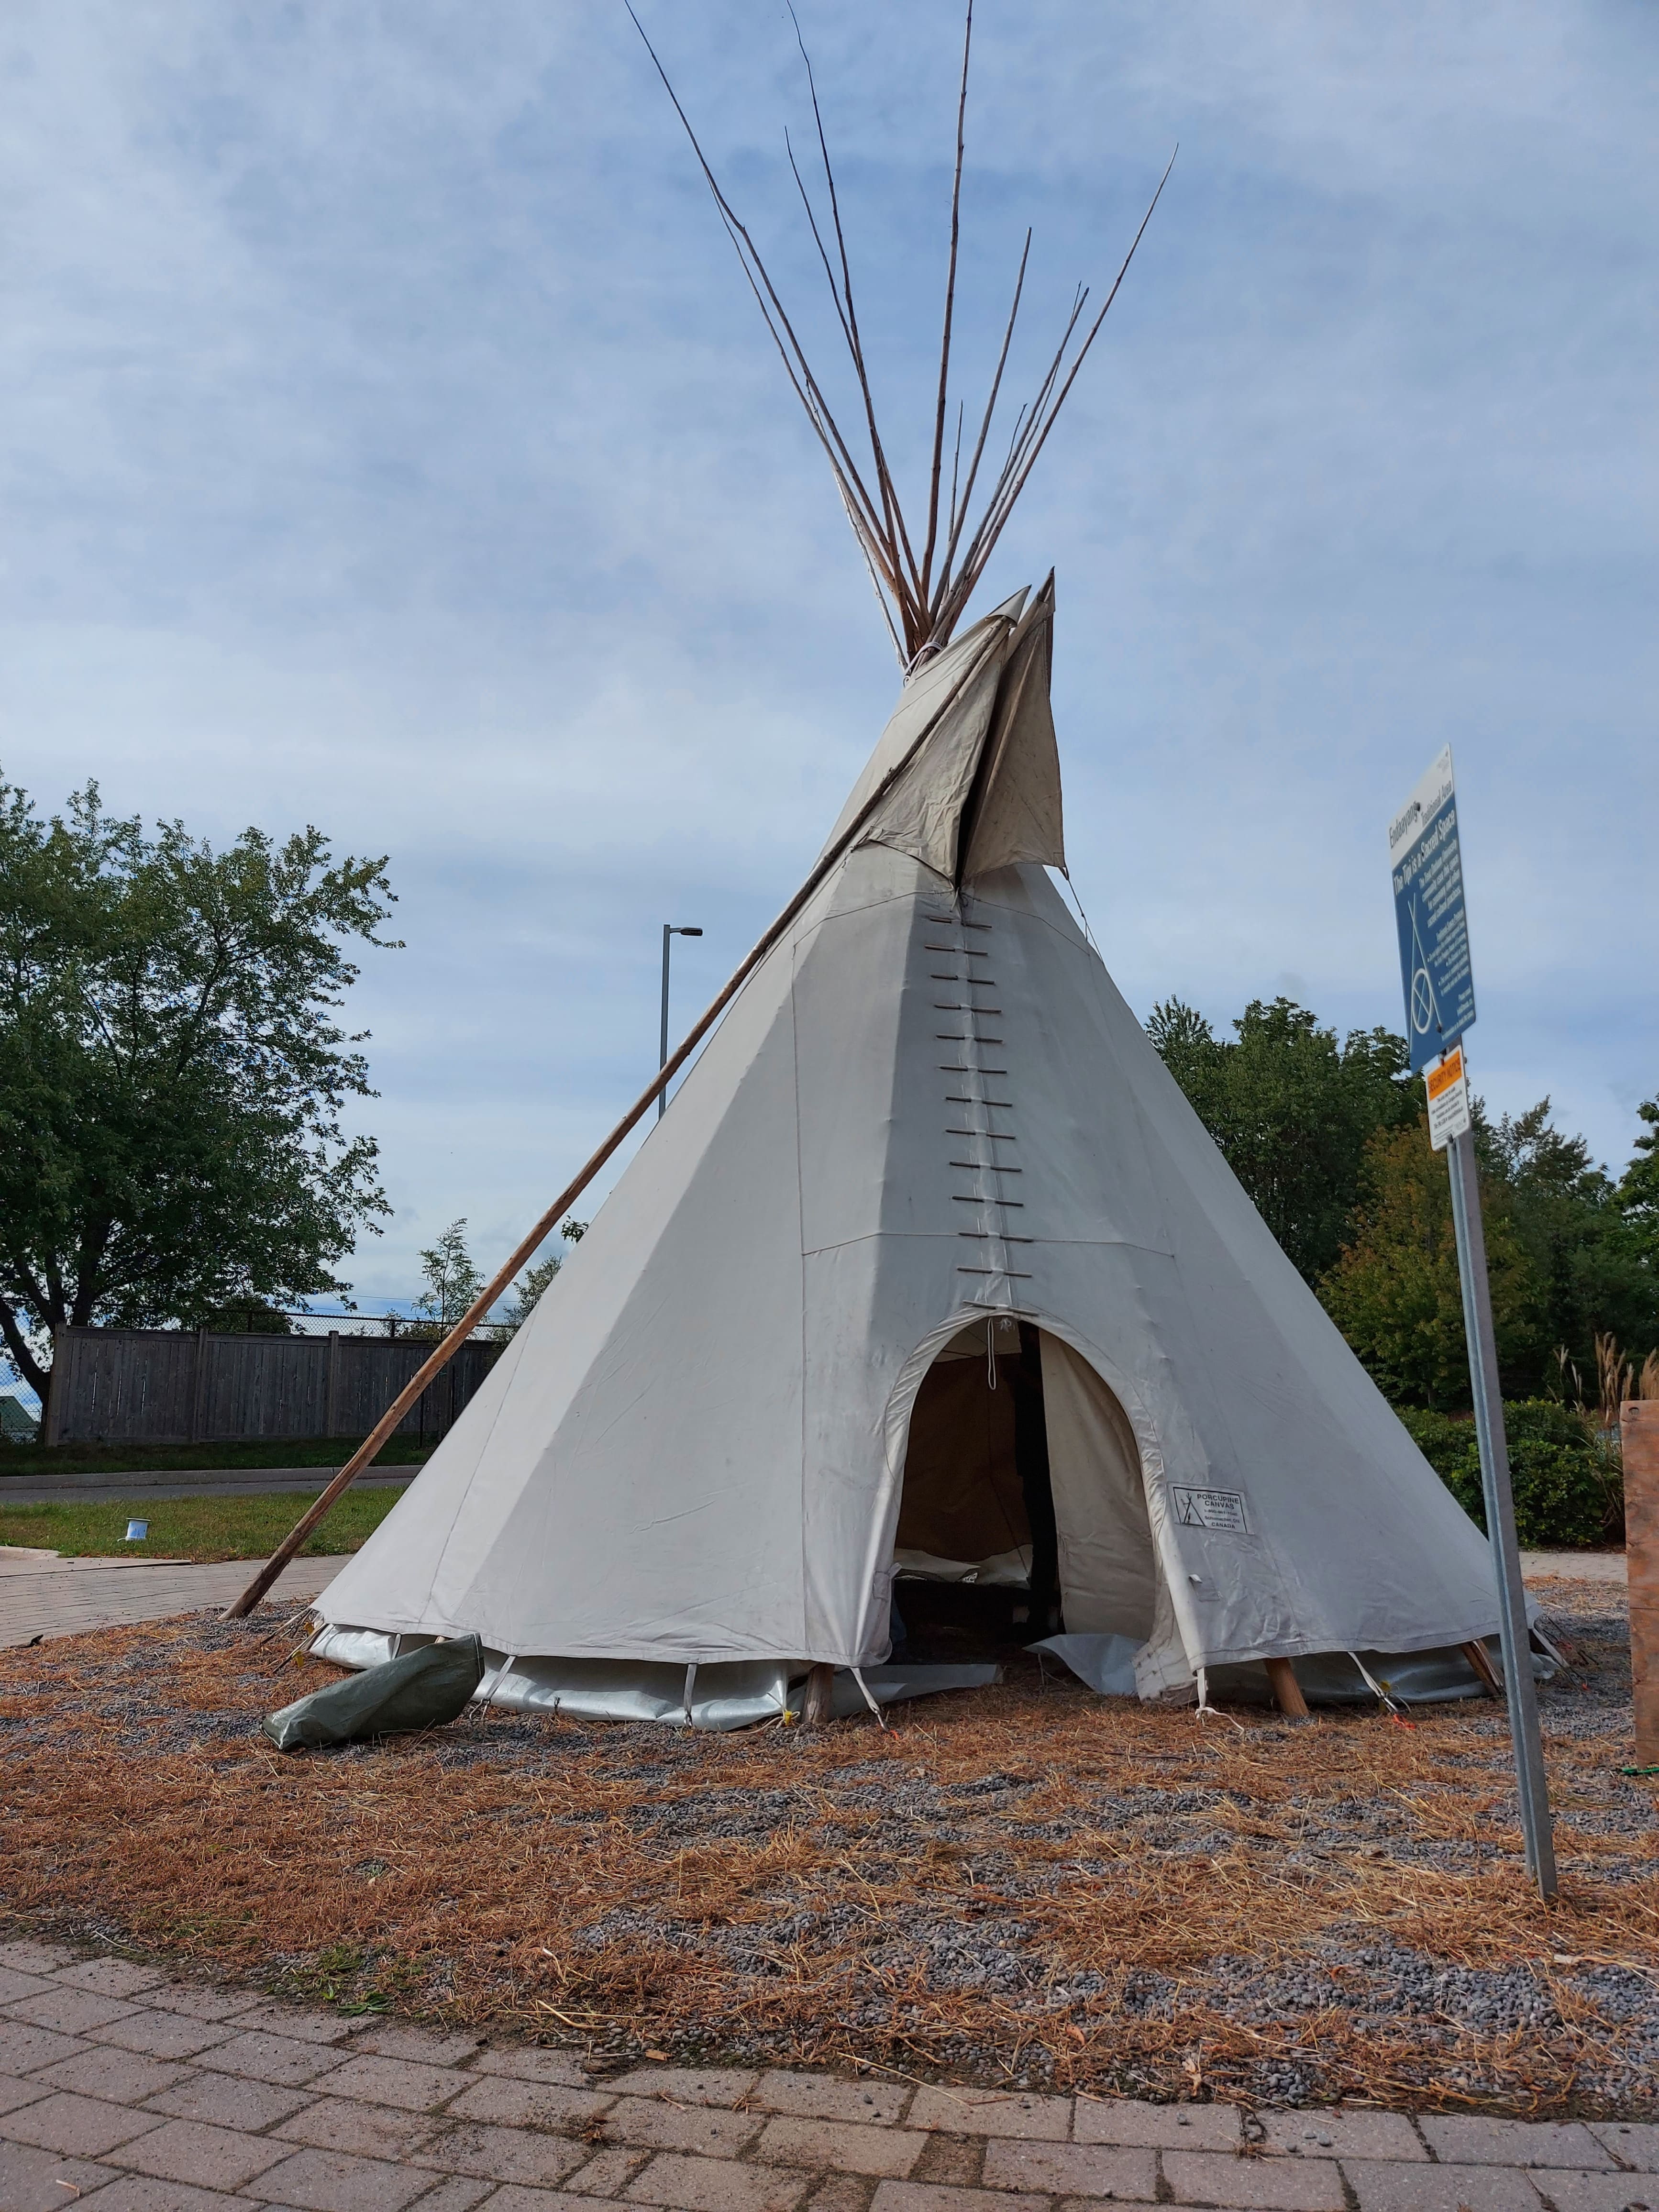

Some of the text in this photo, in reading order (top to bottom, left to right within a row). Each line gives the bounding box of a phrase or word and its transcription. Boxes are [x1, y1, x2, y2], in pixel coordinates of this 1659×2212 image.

[1389, 800, 1417, 850] Endaayang
[1421, 789, 1441, 828] Traditional
[1441, 781, 1451, 802] Area
[1394, 809, 1455, 896] The Tipi is a Sacred Space
[1197, 1494, 1239, 1504] PORCUPINE
[1205, 1500, 1234, 1509] CANVAS
